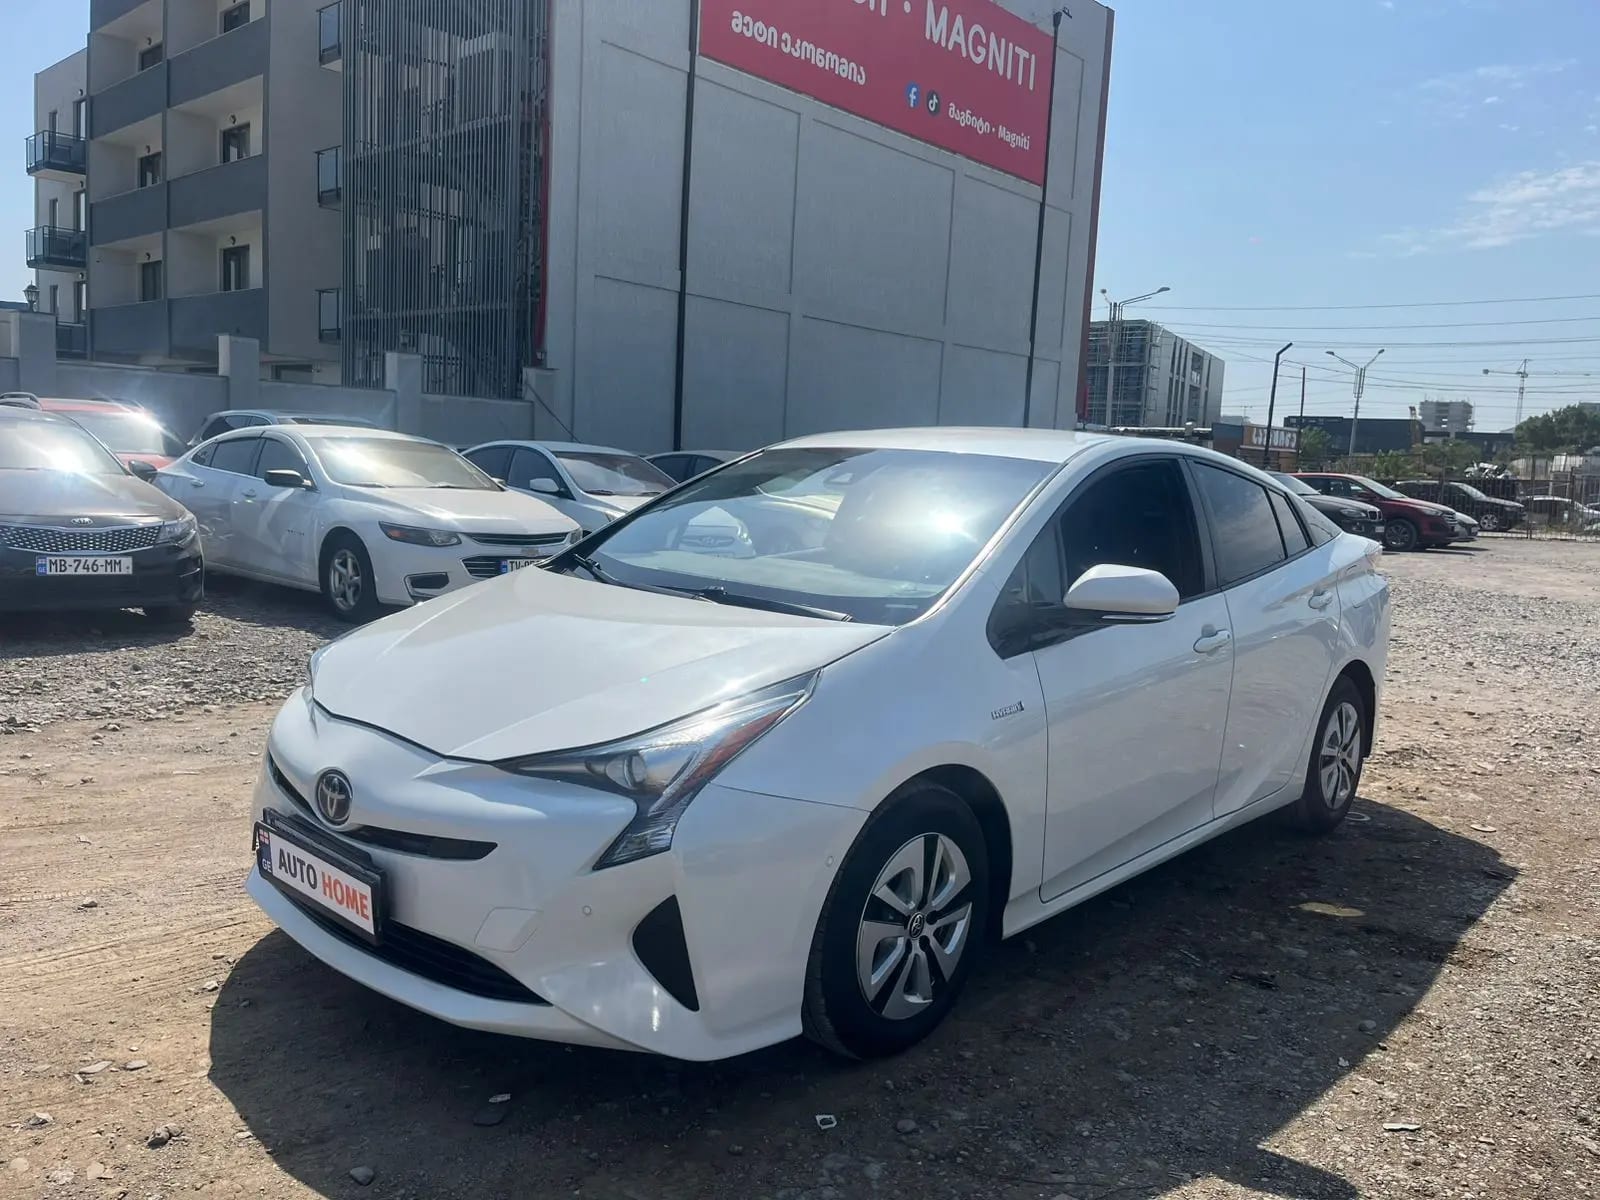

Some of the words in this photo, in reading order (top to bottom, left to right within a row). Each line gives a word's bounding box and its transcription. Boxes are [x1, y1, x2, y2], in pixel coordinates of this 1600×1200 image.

[731, 10, 778, 49] მეტი
[781, 32, 866, 85] ეკონომია
[925, 0, 1036, 91] MAGNITI
[948, 102, 990, 134] მაგნიტი
[998, 125, 1030, 150] Magniti
[49, 558, 123, 573] MB-746-MM
[261, 858, 273, 873] GE
[278, 847, 318, 890] AUTO
[321, 871, 370, 921] HOME
